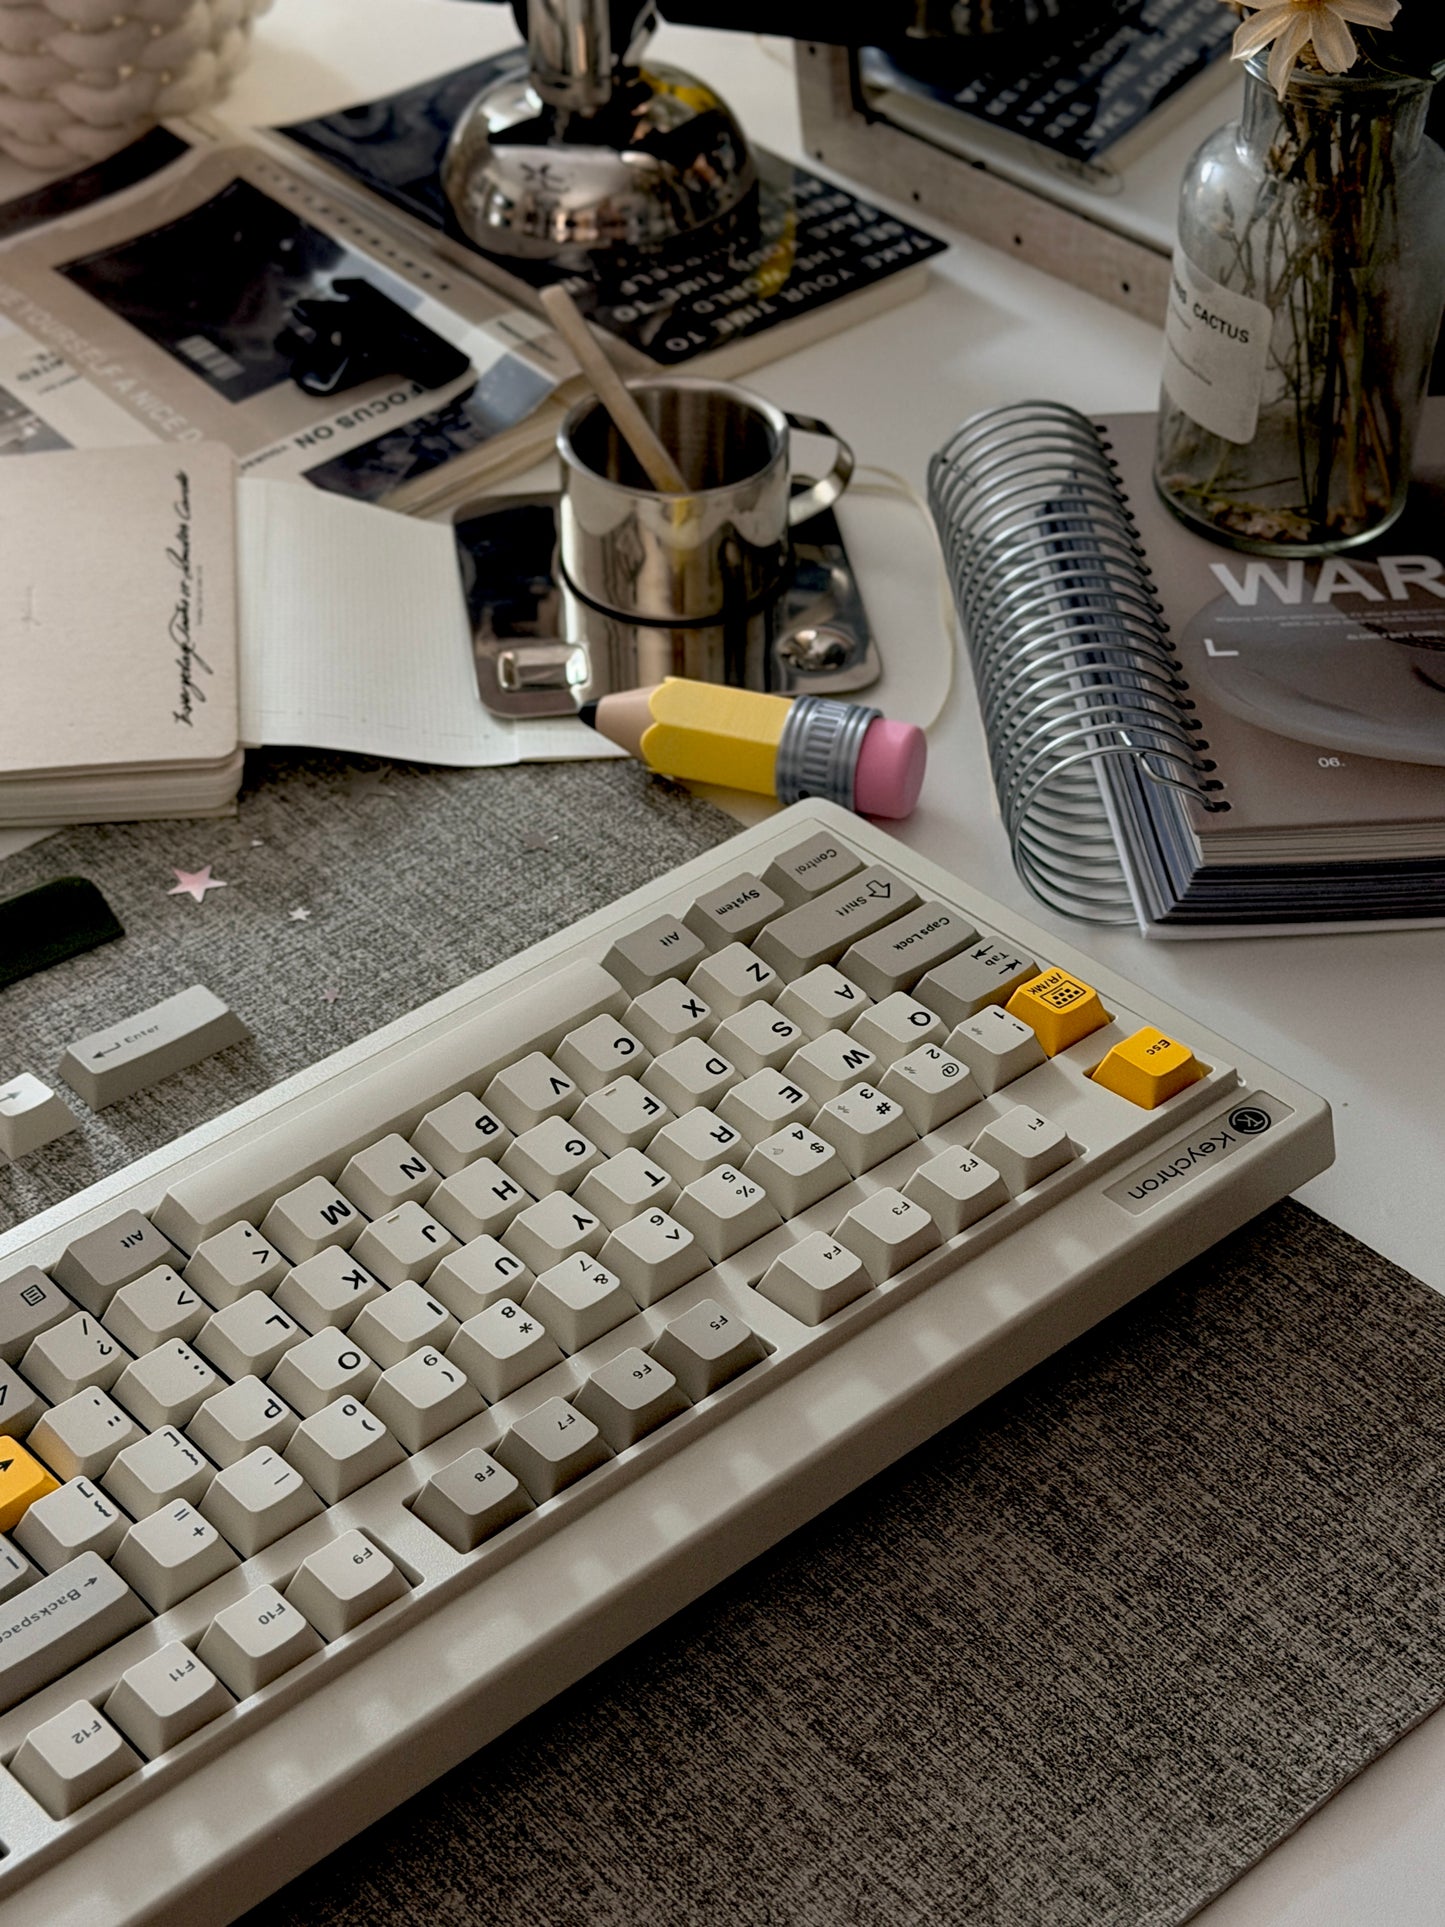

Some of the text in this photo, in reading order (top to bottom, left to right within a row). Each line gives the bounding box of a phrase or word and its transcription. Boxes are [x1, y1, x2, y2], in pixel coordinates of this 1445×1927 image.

[665, 235, 932, 351] TAKE YOUR TIME TO
[1193, 303, 1250, 344] CACTUS
[335, 382, 424, 429] FOCUS
[294, 425, 334, 449] ON
[1209, 554, 1445, 606] WAR
[795, 848, 837, 875] Control
[715, 889, 760, 916] System
[836, 896, 867, 917] Shift
[659, 931, 680, 947] Alt
[892, 917, 950, 951] Caps Lock
[985, 952, 1009, 967] Tab
[745, 961, 771, 983] Z
[833, 984, 855, 1001] A
[681, 998, 706, 1019] X
[993, 1011, 1005, 1021] 1
[906, 1011, 932, 1028] Q
[124, 1024, 160, 1044] Enter
[771, 1020, 793, 1038] S
[613, 1037, 635, 1055] C
[925, 1047, 941, 1061] 2
[1146, 1039, 1171, 1056] Esc
[705, 1058, 728, 1076] D
[842, 1048, 871, 1069] W
[941, 1062, 960, 1078] @
[549, 1077, 570, 1095] V
[778, 1085, 802, 1104] E
[860, 1088, 874, 1099] 3
[642, 1096, 660, 1116] F
[876, 1102, 891, 1115] #
[474, 1115, 499, 1136] B
[1028, 1118, 1045, 1131] F1
[710, 1125, 735, 1144] R
[791, 1130, 804, 1141] 4
[564, 1140, 586, 1157] G
[400, 1156, 427, 1179] N
[960, 1159, 979, 1173] F2
[1128, 1131, 1236, 1199] Keychron
[644, 1170, 666, 1188] T
[721, 1170, 736, 1184] 5
[491, 1180, 517, 1201] H
[736, 1184, 756, 1198] %
[320, 1200, 352, 1225] M
[892, 1202, 910, 1216] F3
[573, 1213, 594, 1232] Y
[649, 1214, 664, 1227] 6
[120, 1229, 144, 1248] Alt
[421, 1225, 437, 1243] J
[823, 1245, 842, 1260] F4
[494, 1256, 519, 1276] U
[579, 1260, 593, 1274] 7
[341, 1269, 368, 1290] K
[592, 1273, 609, 1285] &
[426, 1301, 443, 1316] I
[501, 1305, 517, 1318] 8
[265, 1314, 290, 1329] L
[709, 1315, 729, 1331] F5
[337, 1350, 361, 1370] O
[422, 1354, 438, 1366] 9
[632, 1364, 652, 1380] F6
[264, 1398, 283, 1419] P
[557, 1414, 576, 1431] F7
[474, 1464, 496, 1482] F8
[352, 1546, 374, 1566] F9
[0, 1588, 82, 1643] Backspac
[258, 1602, 287, 1626] F10
[168, 1660, 197, 1682] F11
[71, 1719, 103, 1745] F12
